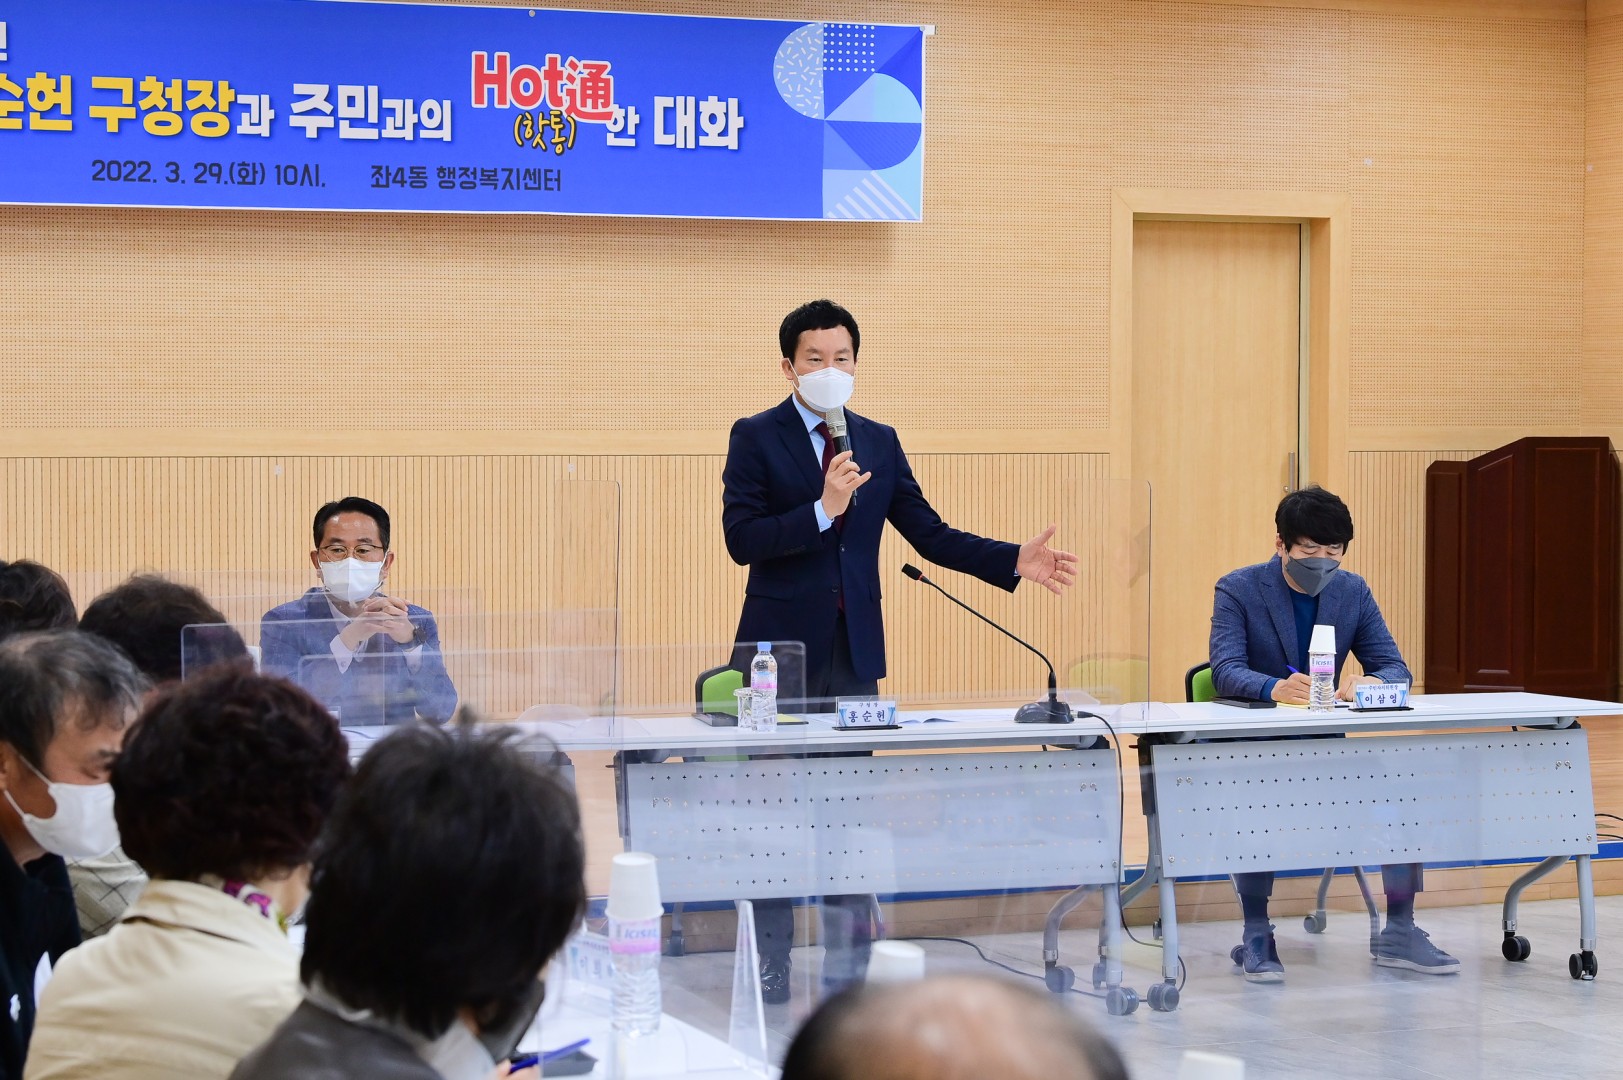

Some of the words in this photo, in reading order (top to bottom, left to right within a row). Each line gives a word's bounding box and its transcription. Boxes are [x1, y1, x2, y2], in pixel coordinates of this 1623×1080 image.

[89, 75, 275, 138] 구청장과
[289, 83, 453, 142] 주민과의
[653, 96, 744, 150] 대화
[91, 159, 157, 184] 2022.
[165, 161, 186, 184] 3.
[193, 161, 266, 186] 29.(화)
[274, 163, 326, 188] 10시.
[371, 165, 428, 189] 좌4동
[436, 166, 561, 192] 행정복지센터
[848, 710, 885, 723] 홍순헌
